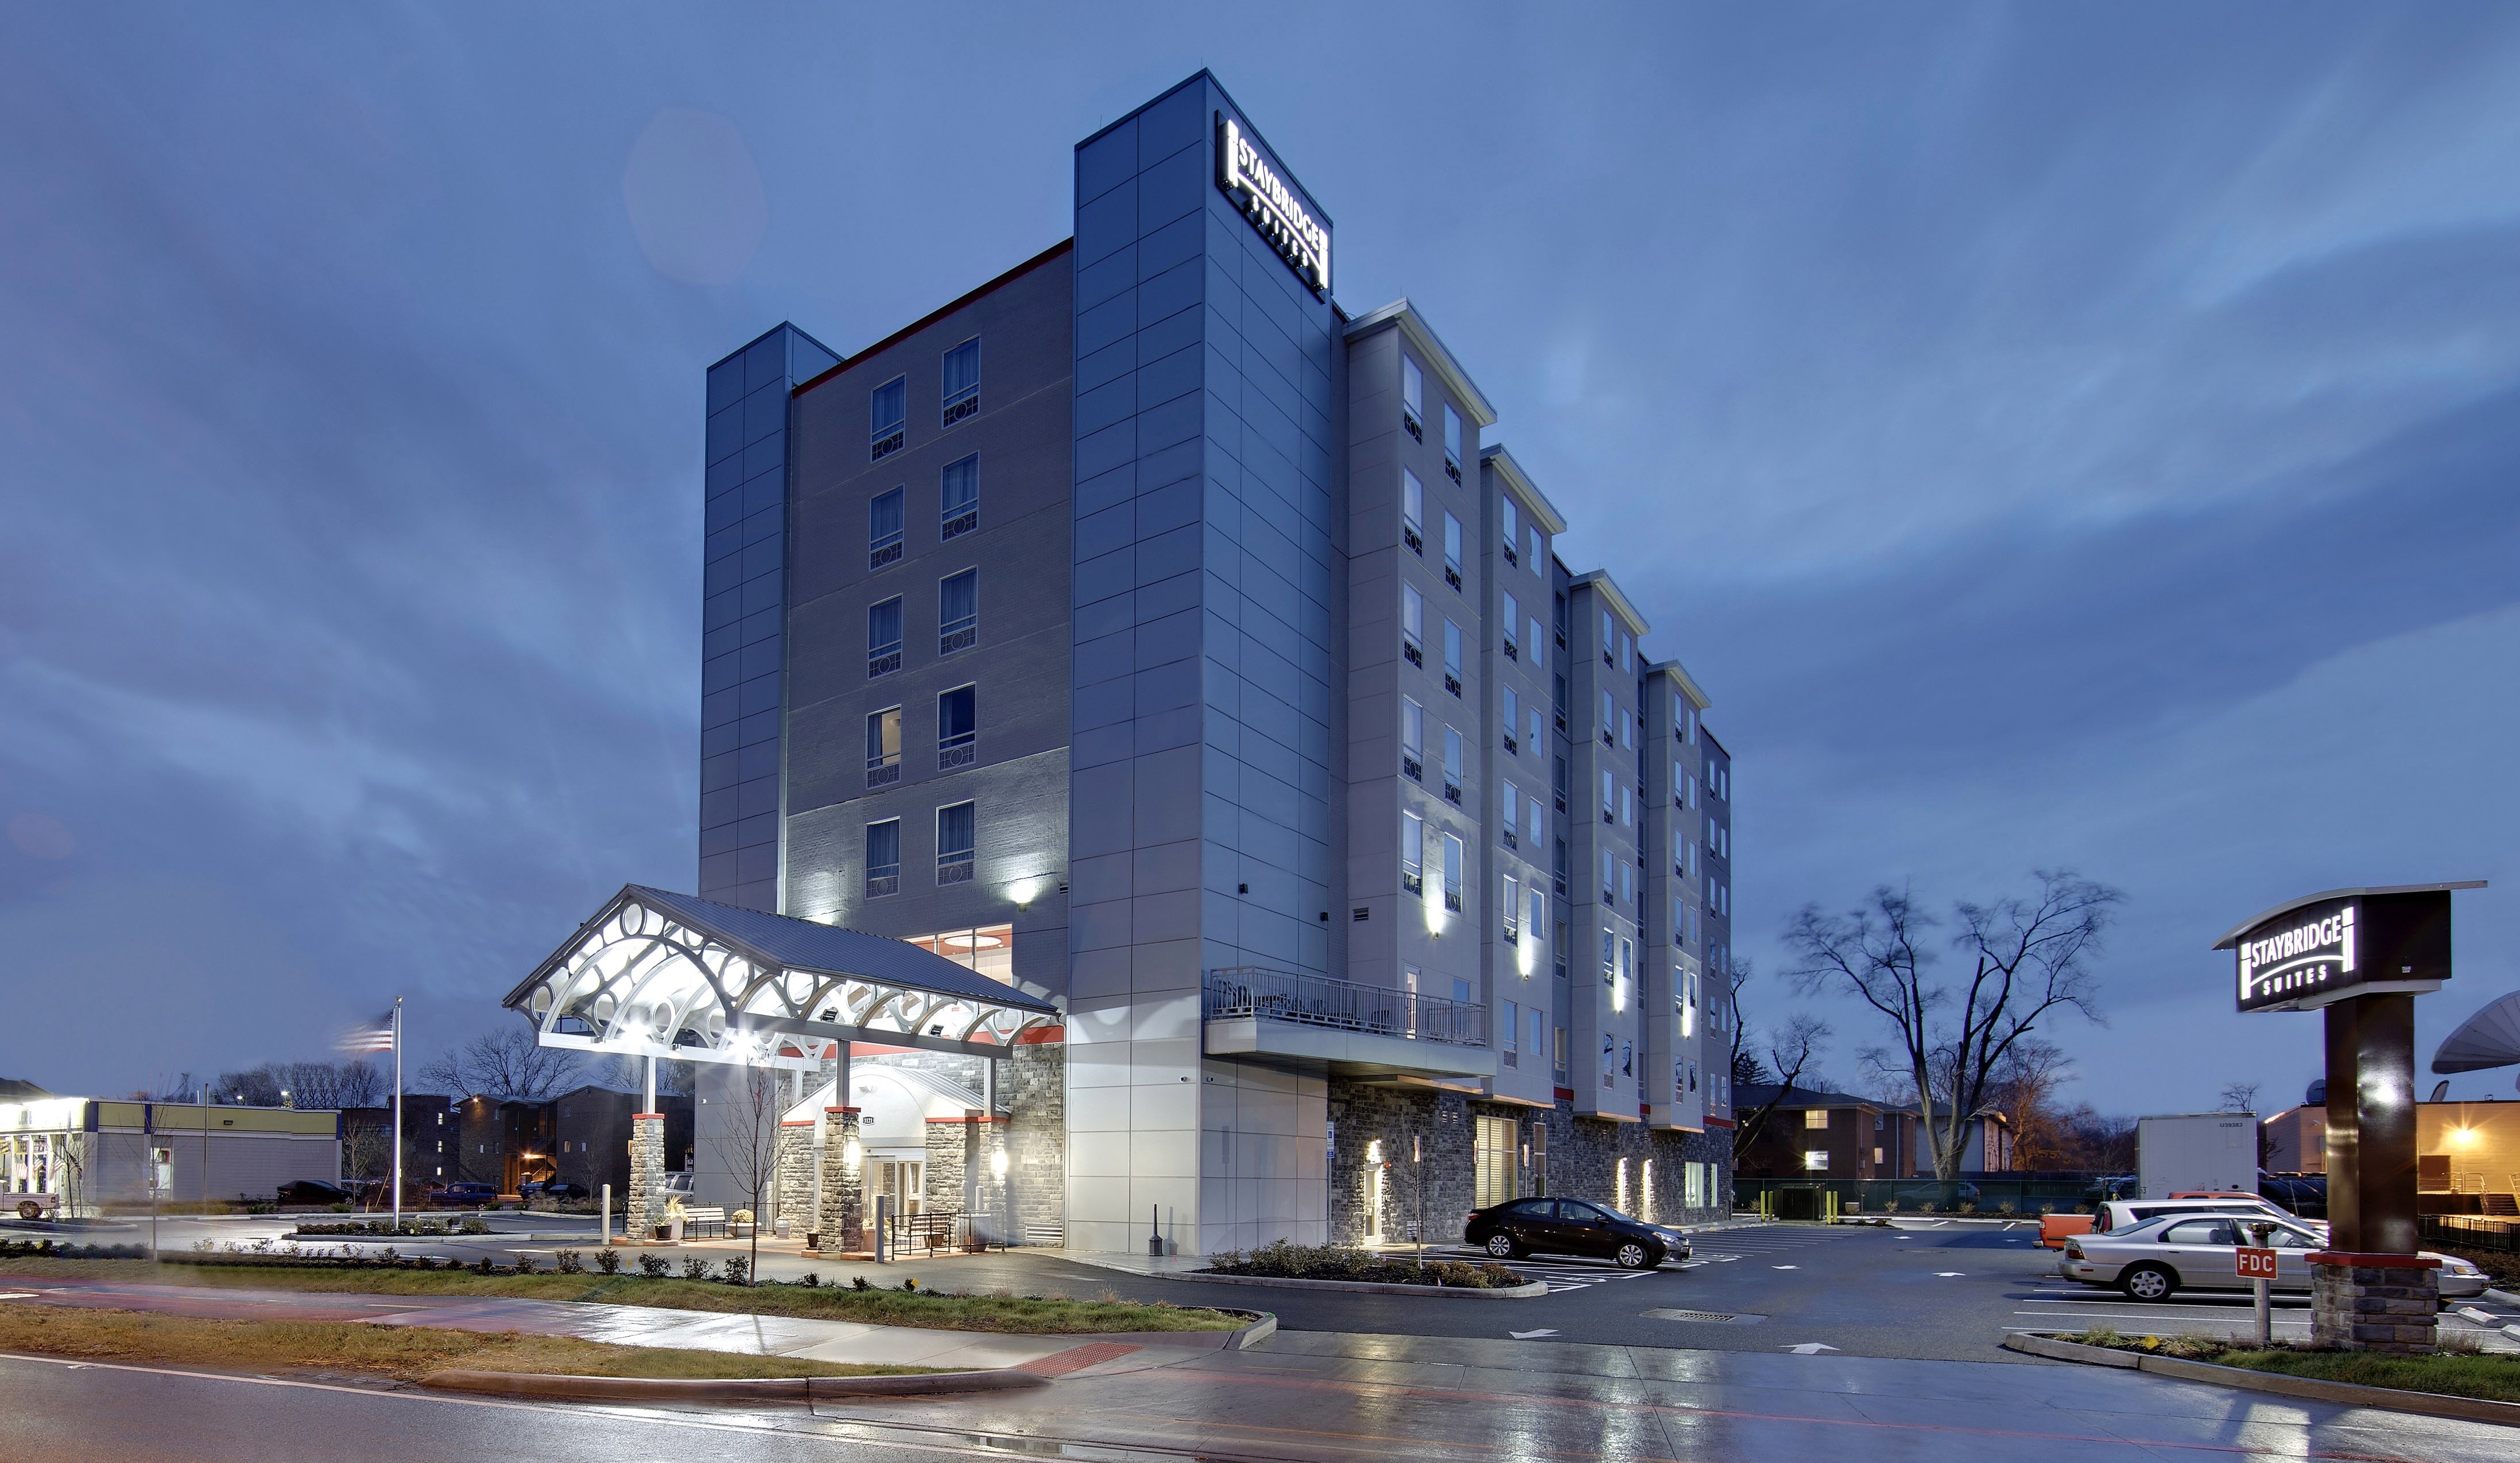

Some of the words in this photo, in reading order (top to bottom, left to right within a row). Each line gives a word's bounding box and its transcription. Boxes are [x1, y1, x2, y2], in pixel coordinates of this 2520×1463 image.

[1239, 138, 1319, 251] STAYBRIDGE
[1253, 195, 1308, 266] SUITES
[2251, 915, 2342, 968] STAYBRIDGE
[2263, 964, 2327, 996] SUITES
[2239, 1254, 2273, 1272] FDC
